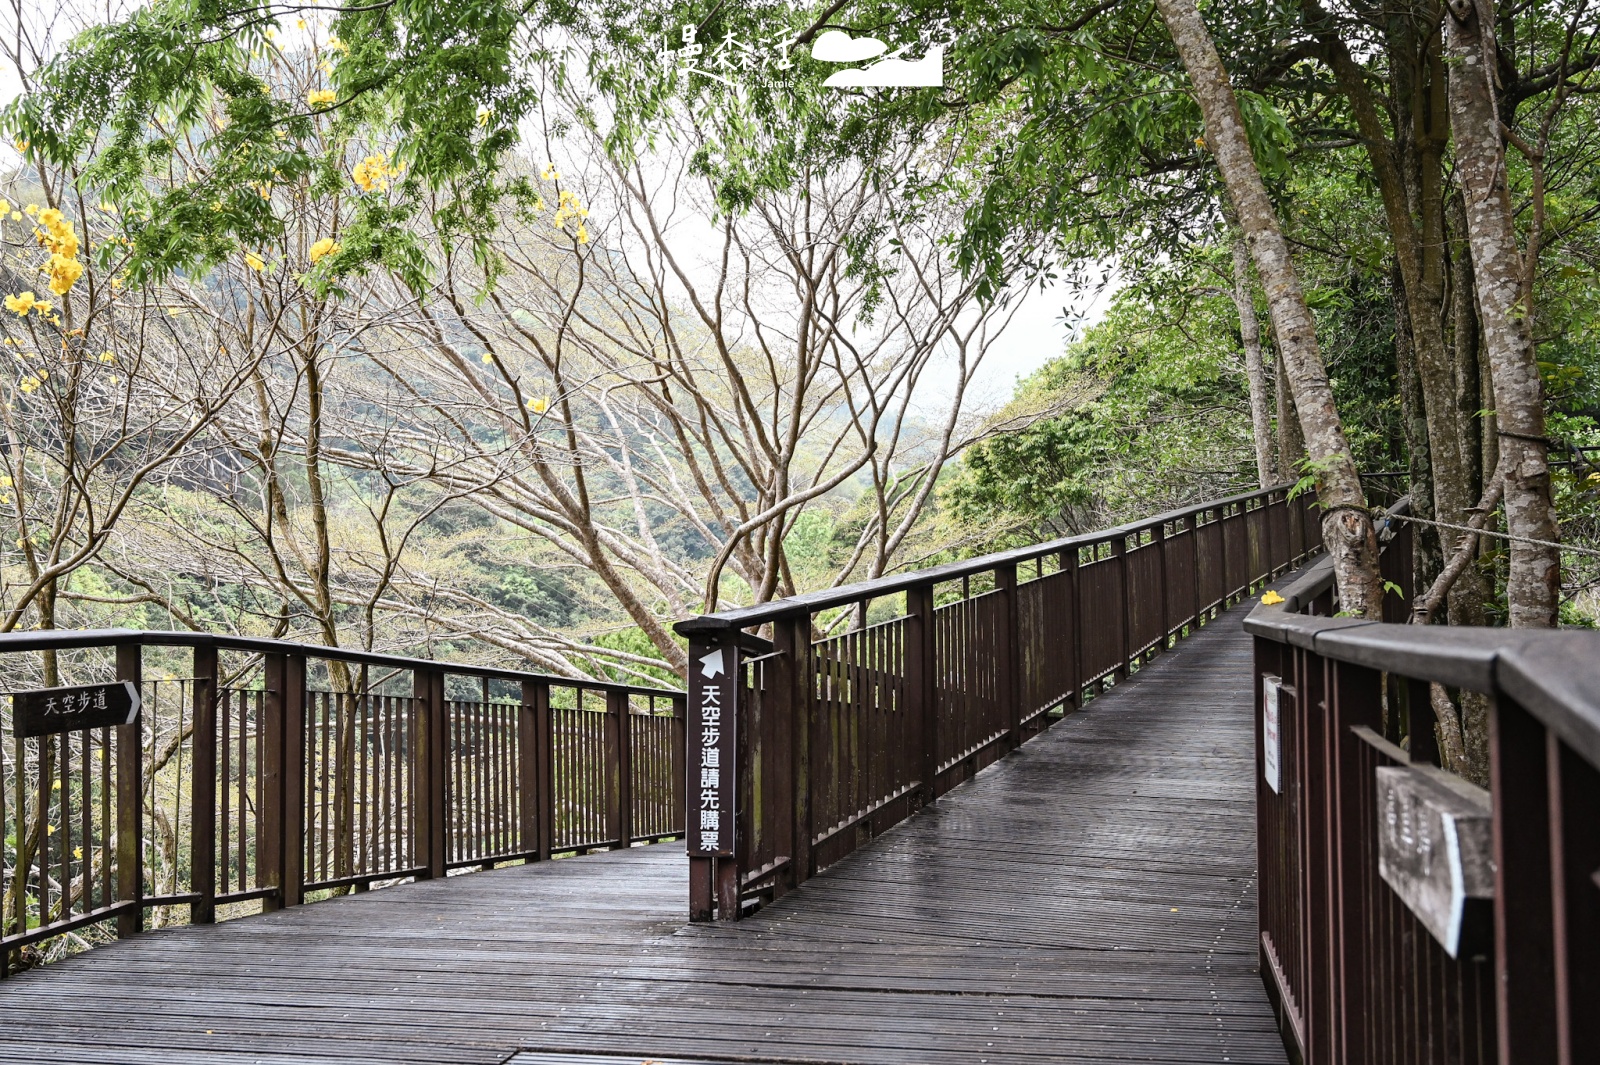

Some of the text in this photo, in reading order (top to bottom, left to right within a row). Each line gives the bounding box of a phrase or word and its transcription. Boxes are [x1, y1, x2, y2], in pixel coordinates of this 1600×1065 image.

[44, 688, 108, 716] 天空步道
[700, 685, 721, 852] 天空步道請先購票
